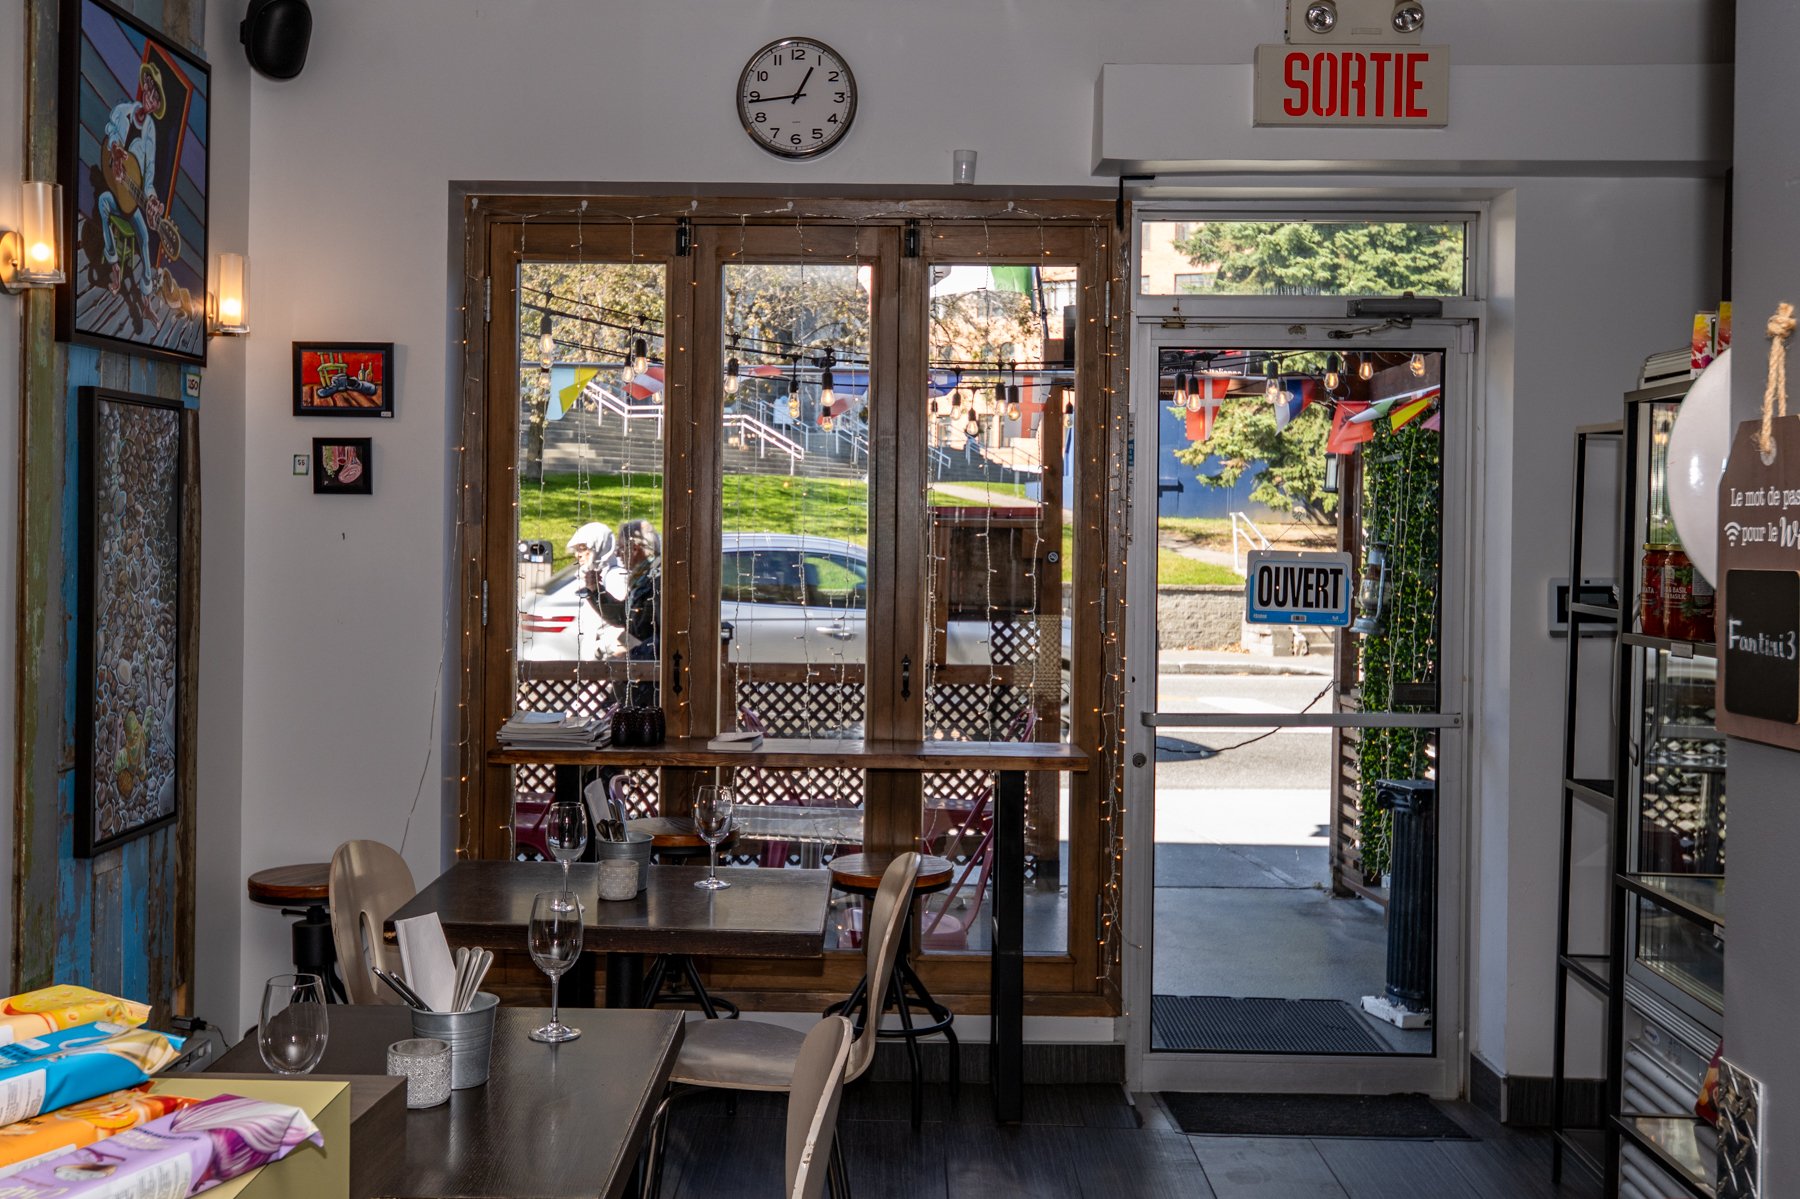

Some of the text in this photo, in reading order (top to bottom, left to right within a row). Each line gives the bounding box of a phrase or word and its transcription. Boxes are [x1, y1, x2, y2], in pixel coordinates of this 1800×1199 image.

[791, 49, 806, 60] 12
[773, 55, 782, 66] 11
[757, 71, 769, 81] 10
[828, 71, 839, 82] 2
[1283, 52, 1429, 118] SORTIE
[749, 91, 761, 102] 9
[833, 92, 845, 103] 3
[755, 112, 767, 123] 8
[827, 113, 838, 124] 4
[770, 128, 780, 138] 7
[812, 129, 823, 139] 5
[791, 134, 802, 145] 6
[1730, 488, 1743, 507] Le
[1745, 487, 1765, 507] mot
[1767, 486, 1780, 506] de
[1741, 526, 1766, 546] pour
[1767, 522, 1778, 542] le
[1257, 565, 1343, 609] OUVERT
